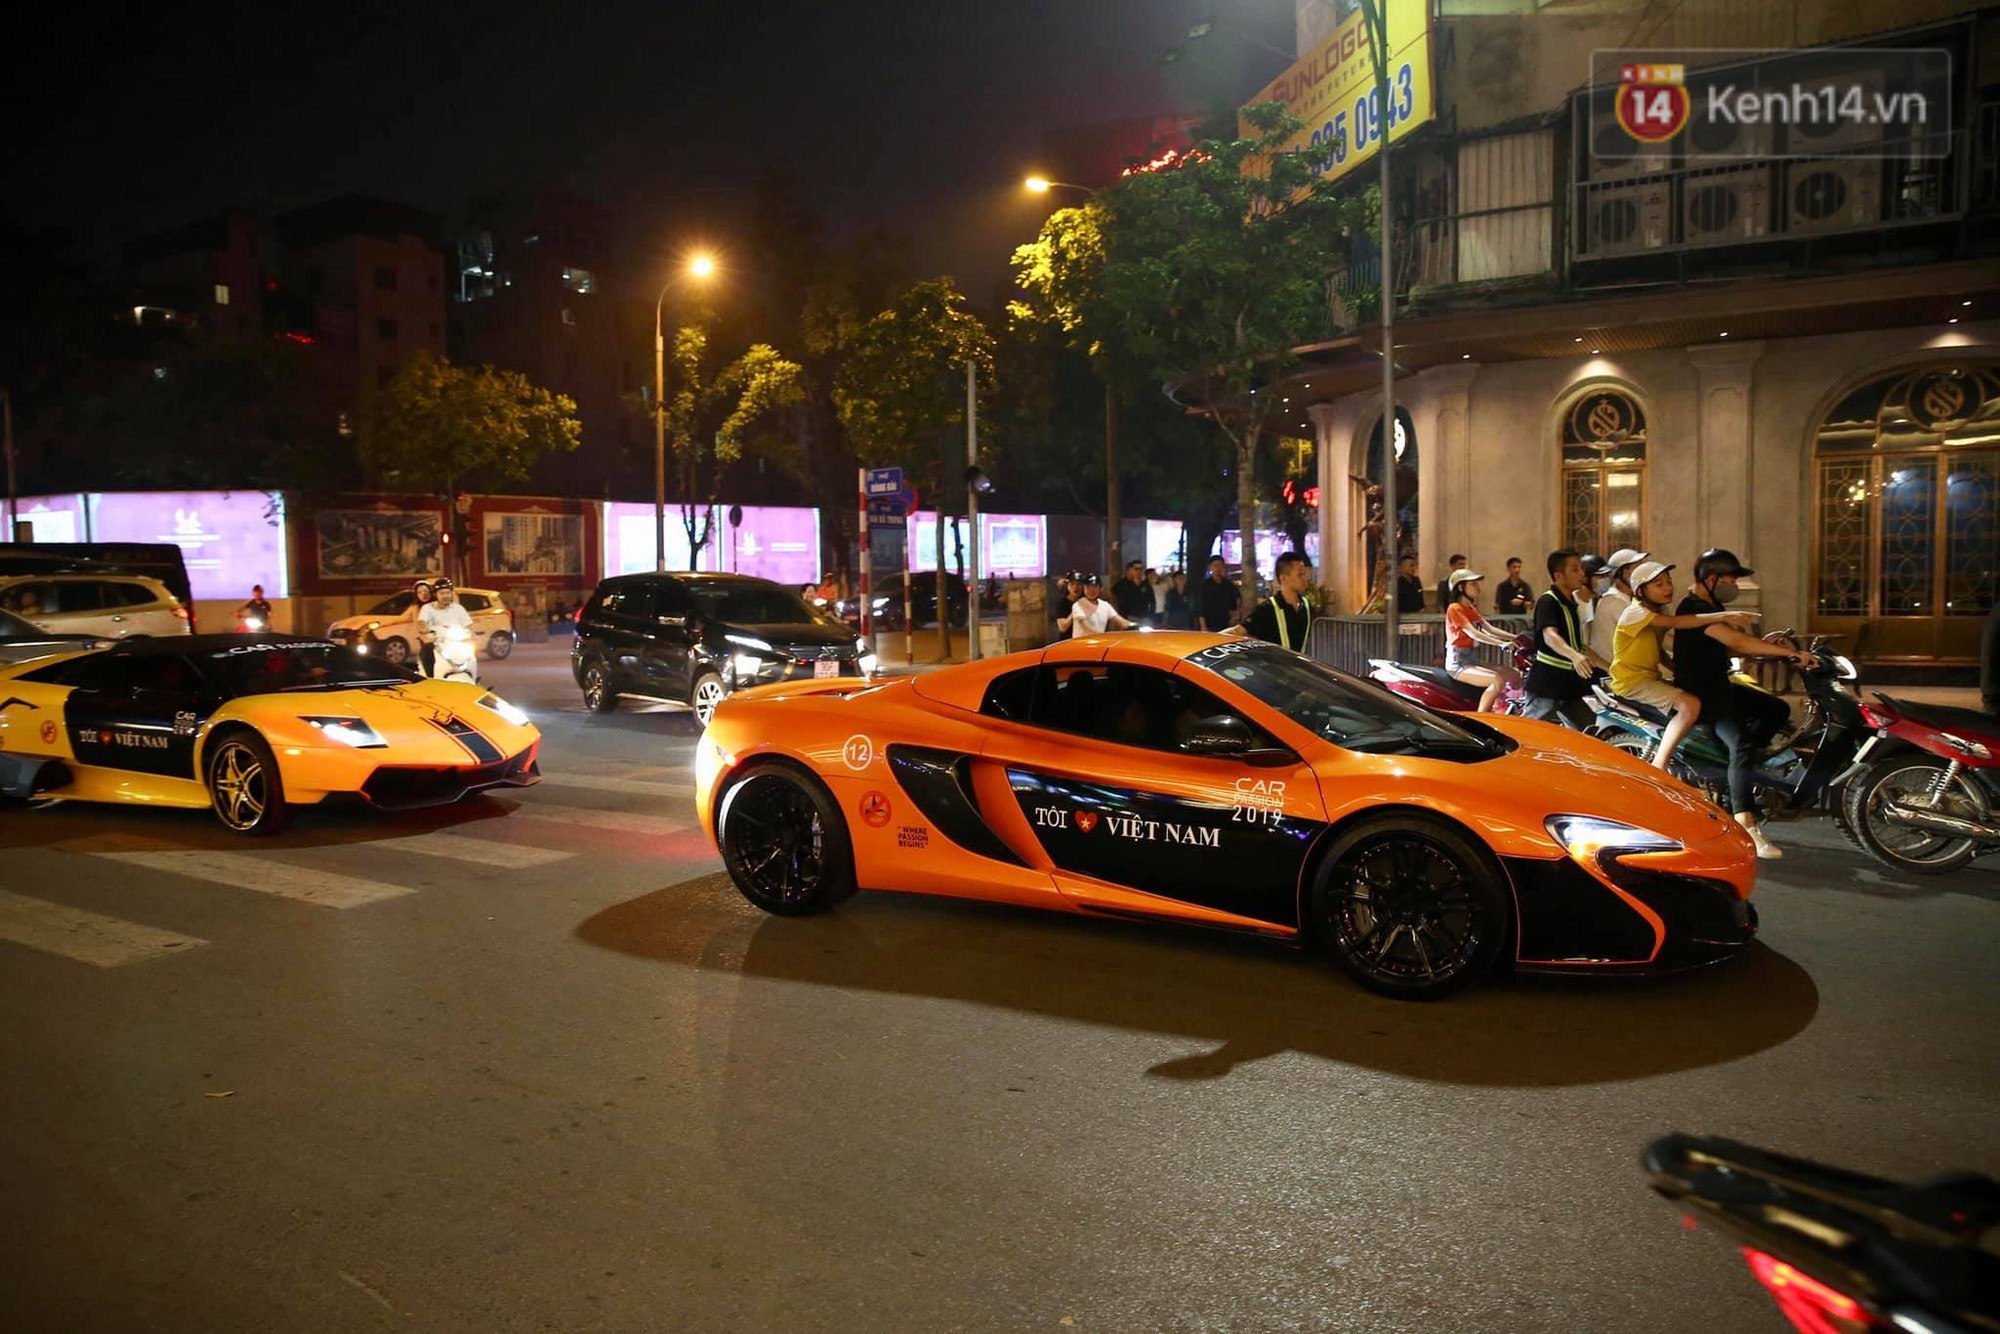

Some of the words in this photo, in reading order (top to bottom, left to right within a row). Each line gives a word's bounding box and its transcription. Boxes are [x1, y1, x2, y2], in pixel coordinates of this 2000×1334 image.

[175, 711, 196, 721] CAR
[142, 735, 168, 749] NAM
[849, 744, 868, 761] 12
[1235, 777, 1286, 796] CAR
[1232, 805, 1282, 826] 2019
[1035, 805, 1068, 829] TÔI
[1106, 813, 1160, 842] VIỆT
[1164, 822, 1221, 848] NAM
[898, 833, 928, 842] PASSION
